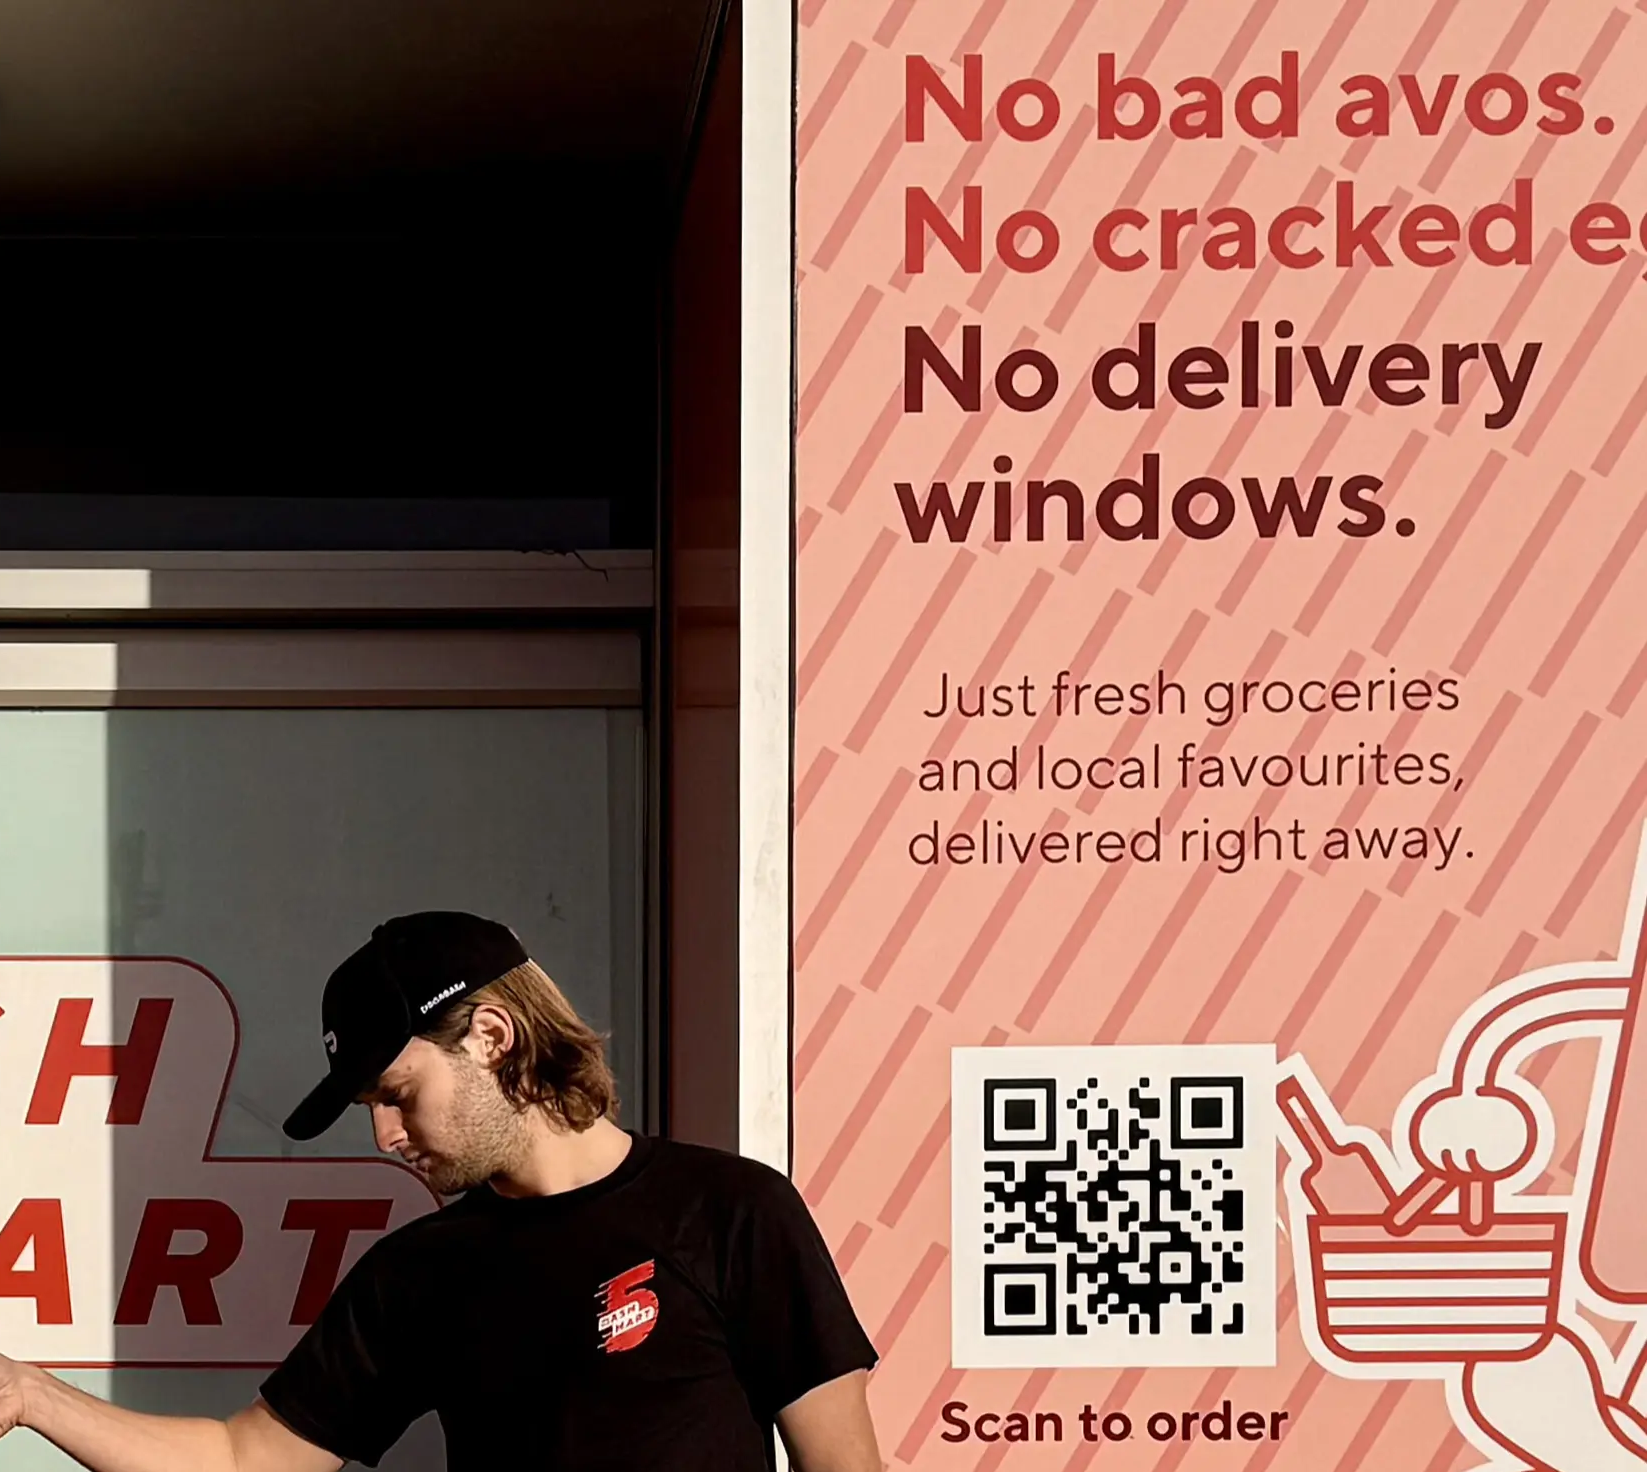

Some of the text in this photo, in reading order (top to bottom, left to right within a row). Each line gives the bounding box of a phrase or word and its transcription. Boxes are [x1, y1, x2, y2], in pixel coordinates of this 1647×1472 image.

[904, 50, 1615, 143] No bad avos.
[904, 178, 1647, 283] No cracked e
[904, 319, 1543, 429] No delivery
[893, 453, 1416, 543] windows.
[922, 667, 1460, 726] Just fresh groceries
[917, 741, 1465, 792] and local favourites,
[908, 816, 1474, 873] delivered right away.
[940, 1399, 1289, 1442] Scan to order
